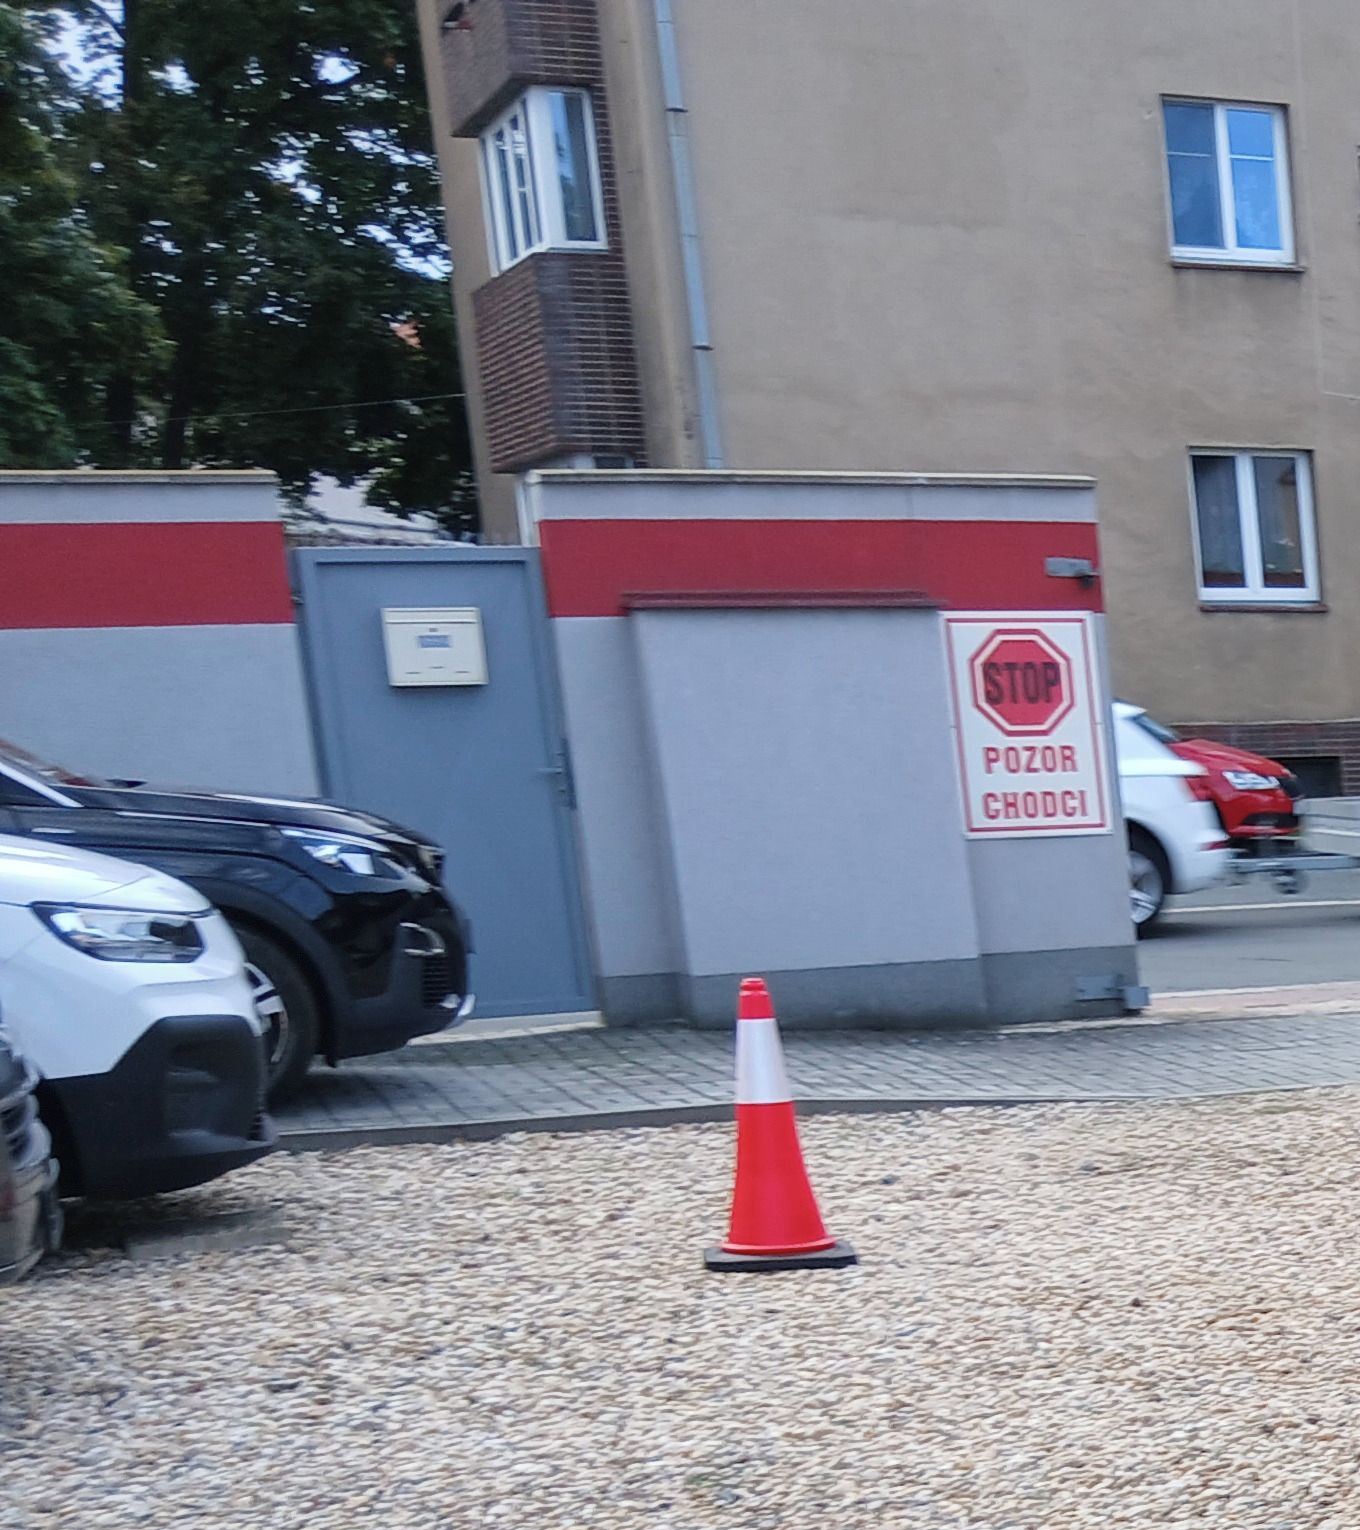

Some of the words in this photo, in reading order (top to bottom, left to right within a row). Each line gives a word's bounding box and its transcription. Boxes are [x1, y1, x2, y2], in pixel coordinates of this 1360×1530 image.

[984, 661, 1061, 704] STOP
[983, 745, 1077, 774] POZOR
[982, 789, 1088, 820] CHODCI
